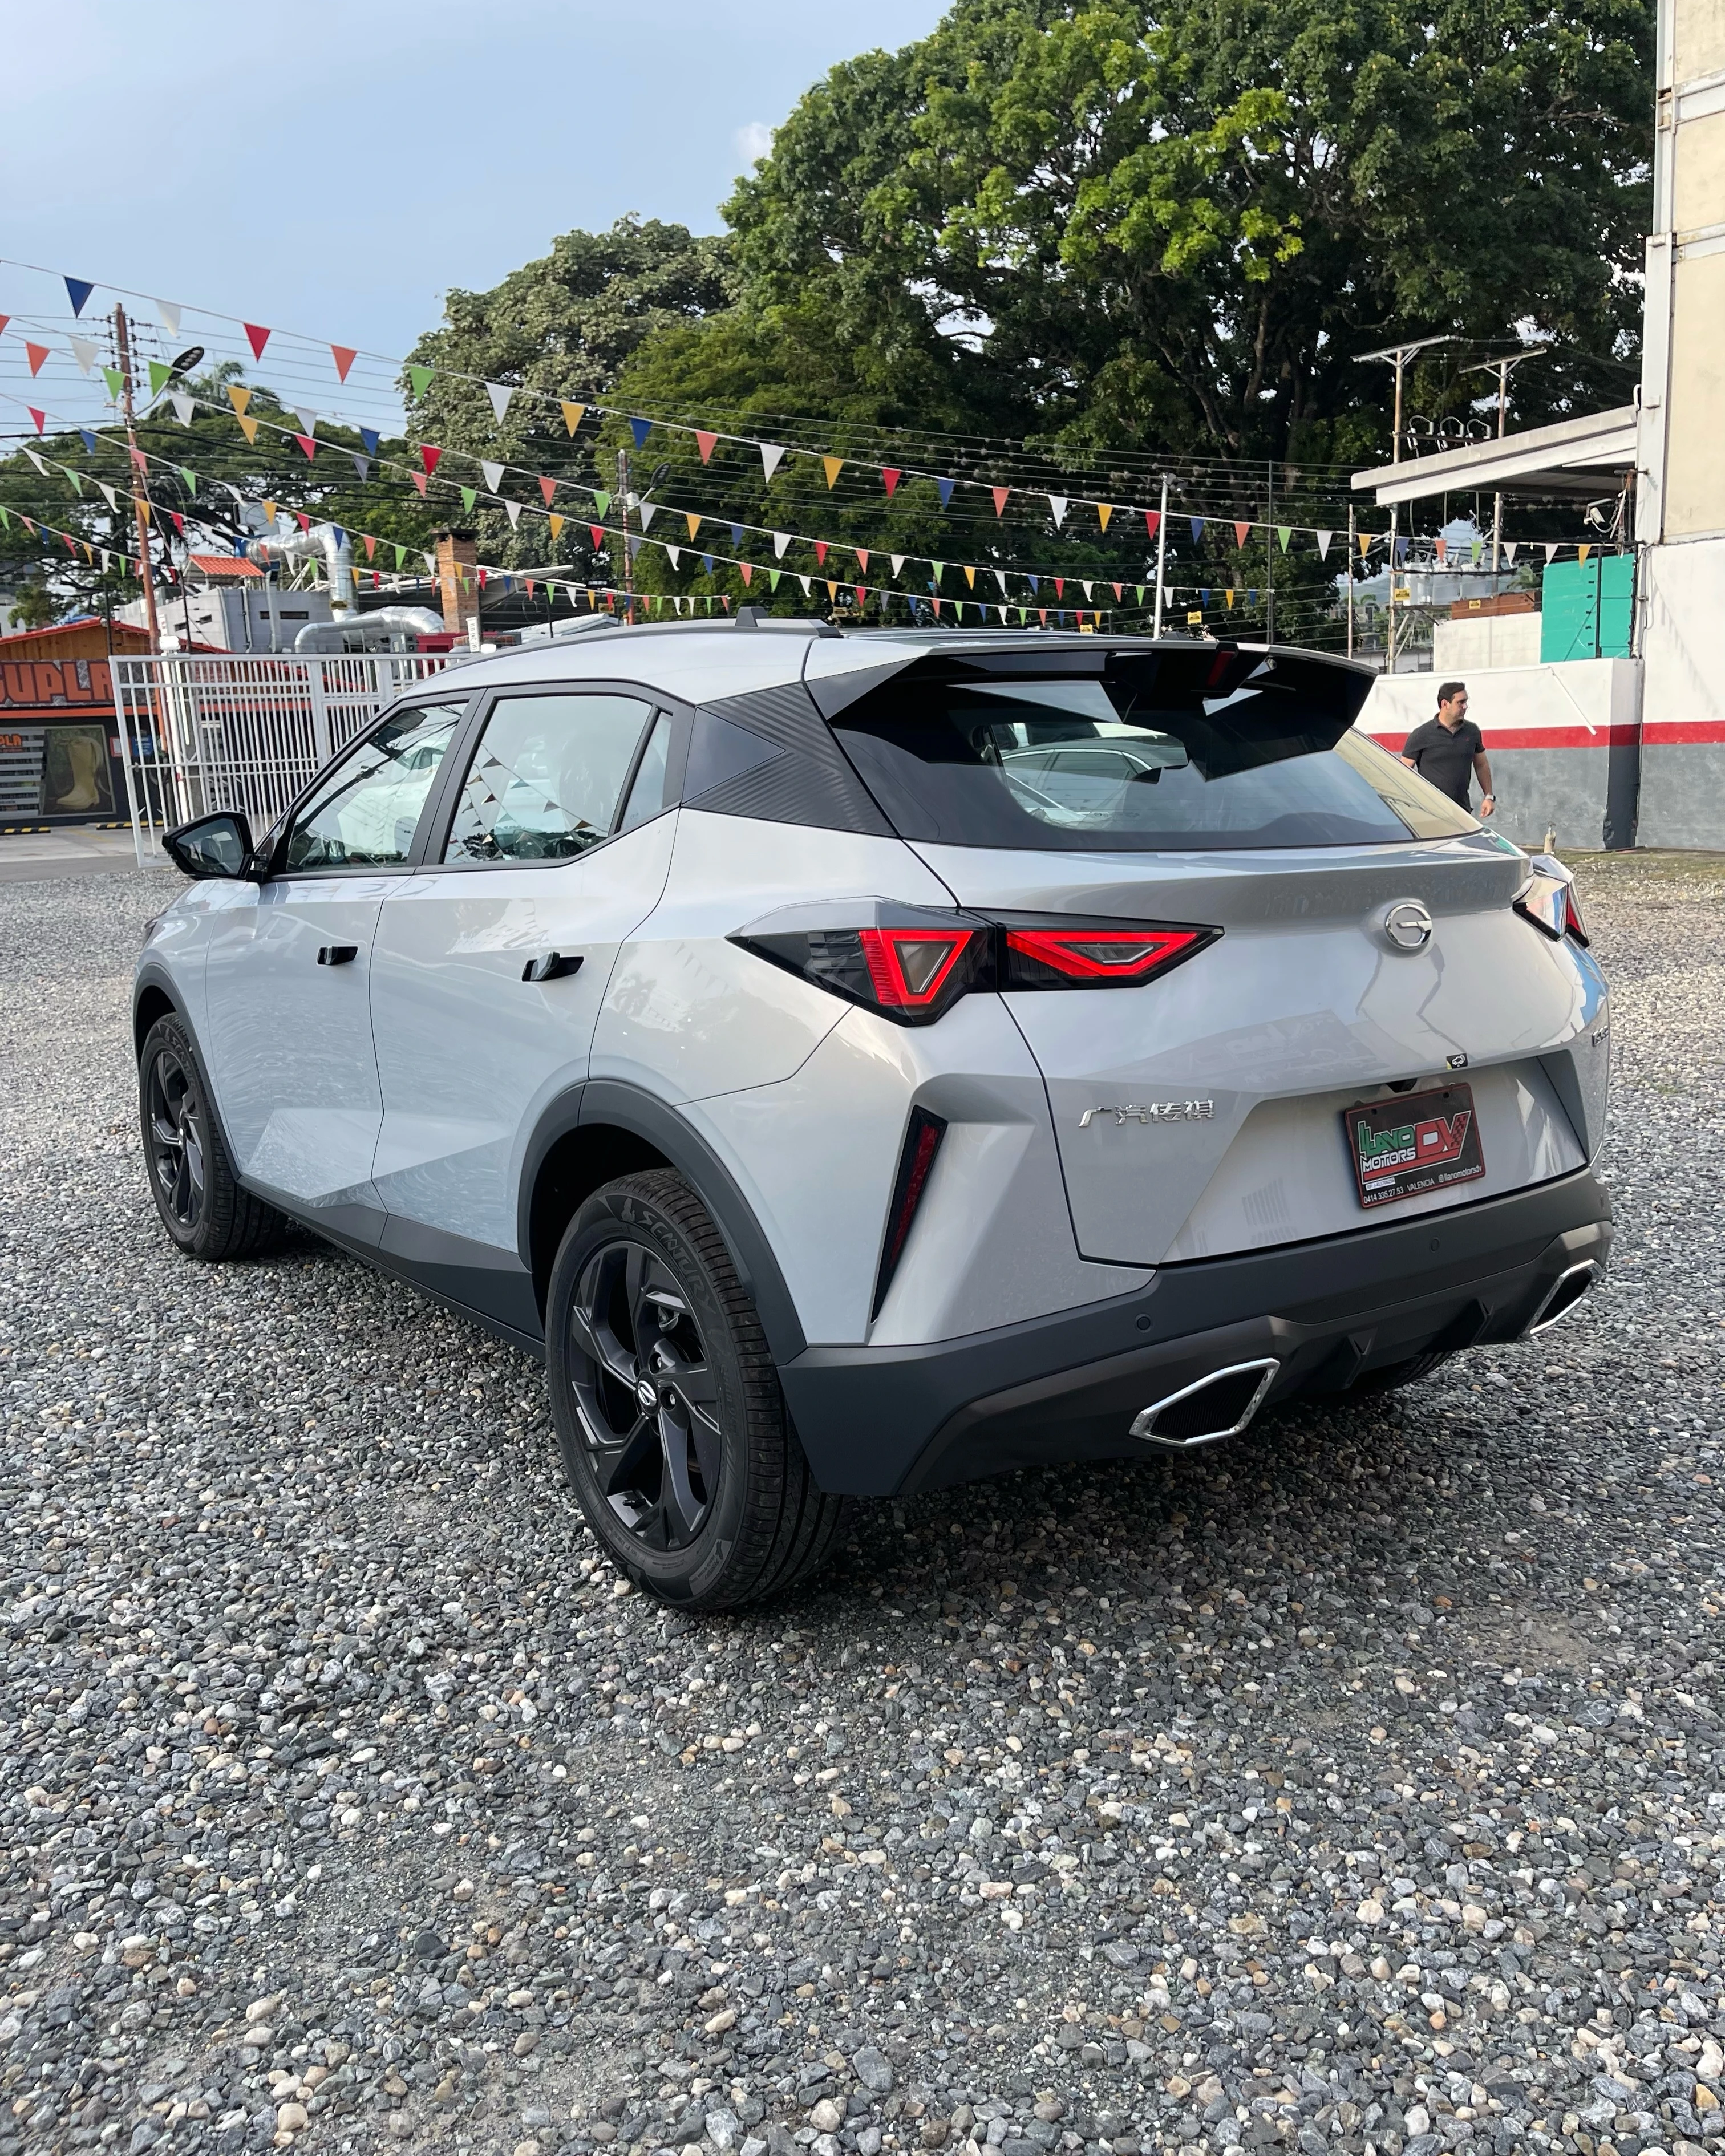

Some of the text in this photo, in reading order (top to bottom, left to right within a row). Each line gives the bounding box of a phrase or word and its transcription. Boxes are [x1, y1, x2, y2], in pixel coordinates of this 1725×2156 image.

[0, 662, 114, 702] UPLA
[1078, 1099, 1214, 1127] 广汽传祺
[1363, 1148, 1415, 1172] MOTORS
[1364, 1194, 1377, 1203] 0414
[1407, 1178, 1435, 1192] VALENCIA
[637, 1210, 717, 1315] SENTURY
